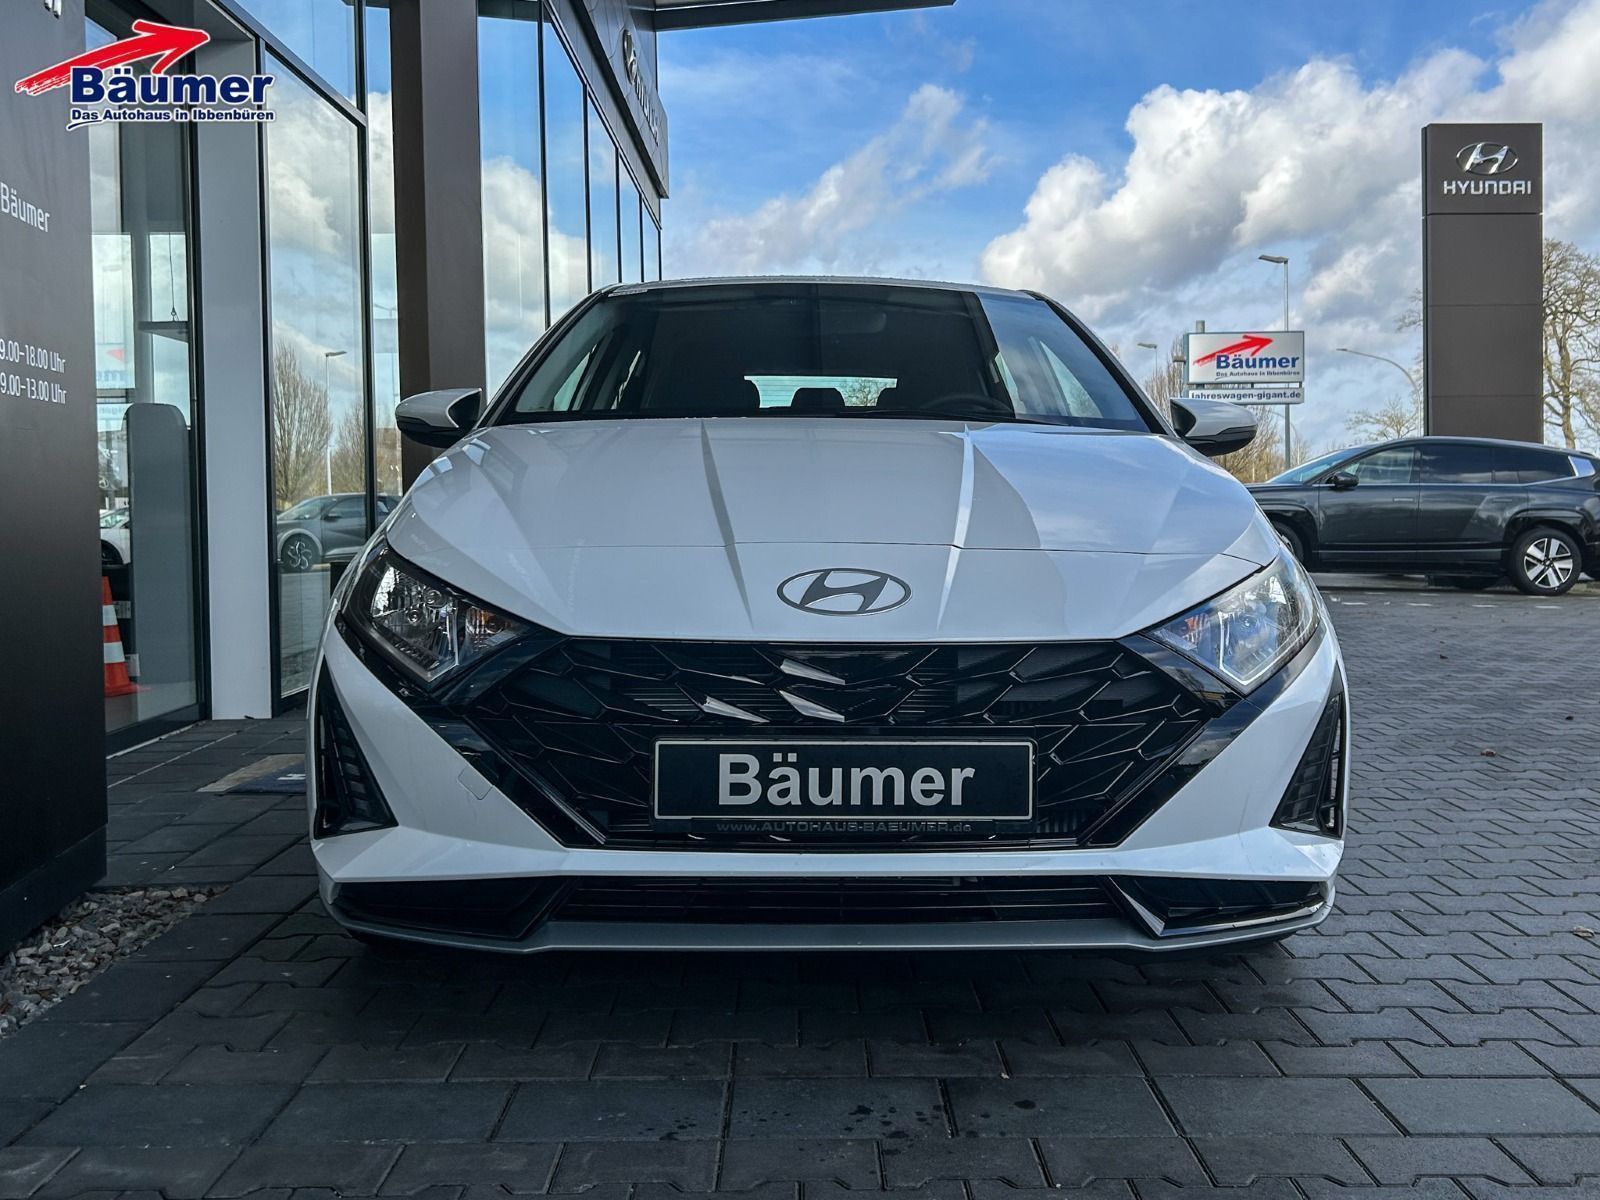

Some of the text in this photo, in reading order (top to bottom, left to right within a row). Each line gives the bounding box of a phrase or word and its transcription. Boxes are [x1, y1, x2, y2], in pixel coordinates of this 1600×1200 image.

[1443, 181, 1532, 195] HYUNDAI
[0, 182, 51, 233] Bäumer
[50, 351, 66, 374] Uhr
[1216, 354, 1300, 369] Bäumer
[51, 383, 67, 405] Uhr
[718, 752, 976, 807] Bäumer
